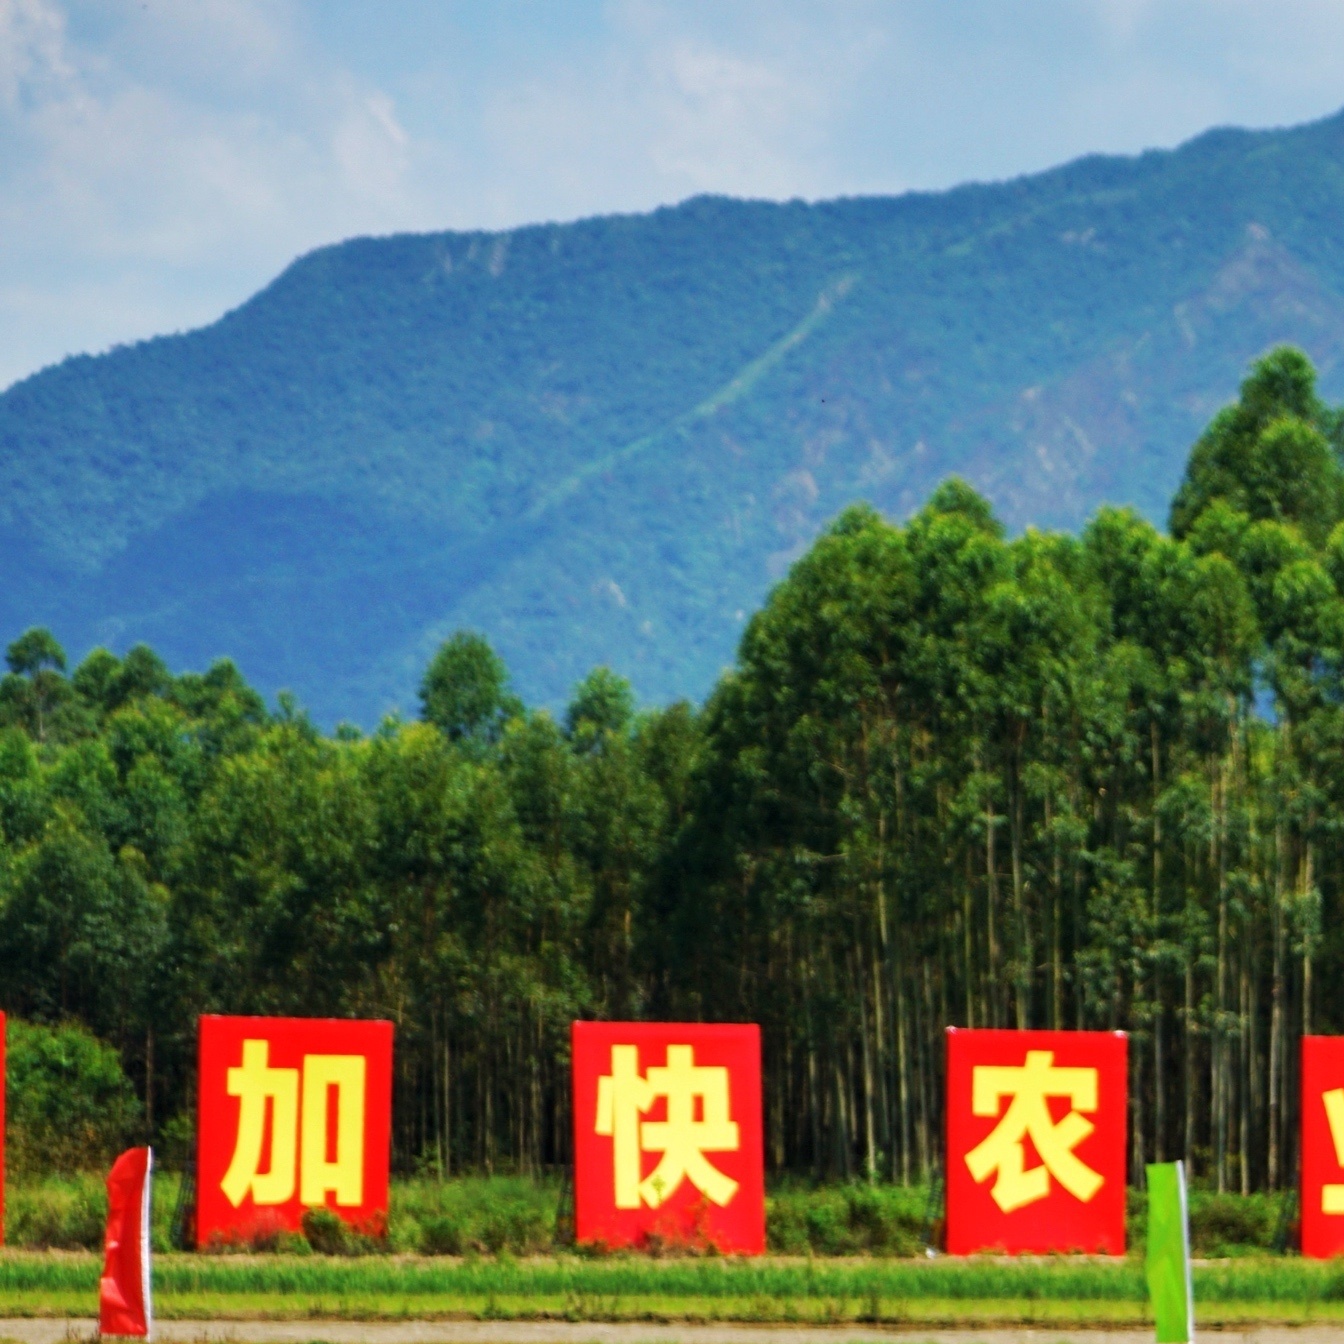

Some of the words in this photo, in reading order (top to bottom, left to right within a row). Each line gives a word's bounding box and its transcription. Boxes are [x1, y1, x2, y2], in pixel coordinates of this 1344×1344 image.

[221, 1039, 365, 1207] 加
[595, 1044, 739, 1210] 快
[964, 1050, 1104, 1212] 农
